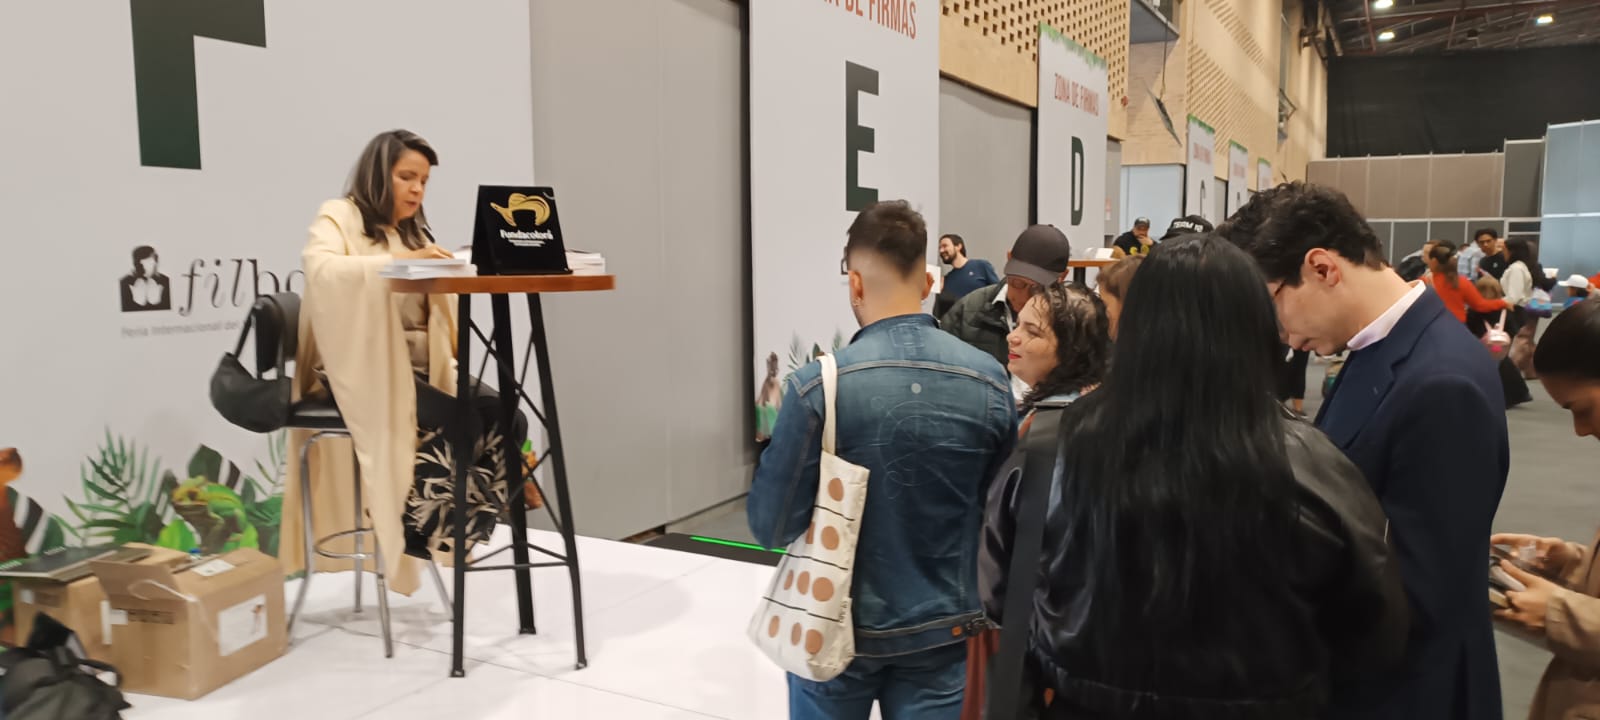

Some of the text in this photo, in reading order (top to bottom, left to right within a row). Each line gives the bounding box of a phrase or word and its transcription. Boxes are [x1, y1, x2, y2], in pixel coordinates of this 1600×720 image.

[868, 0, 916, 40] FIRMAS
[846, 60, 880, 212] E
[1071, 136, 1085, 226] D
